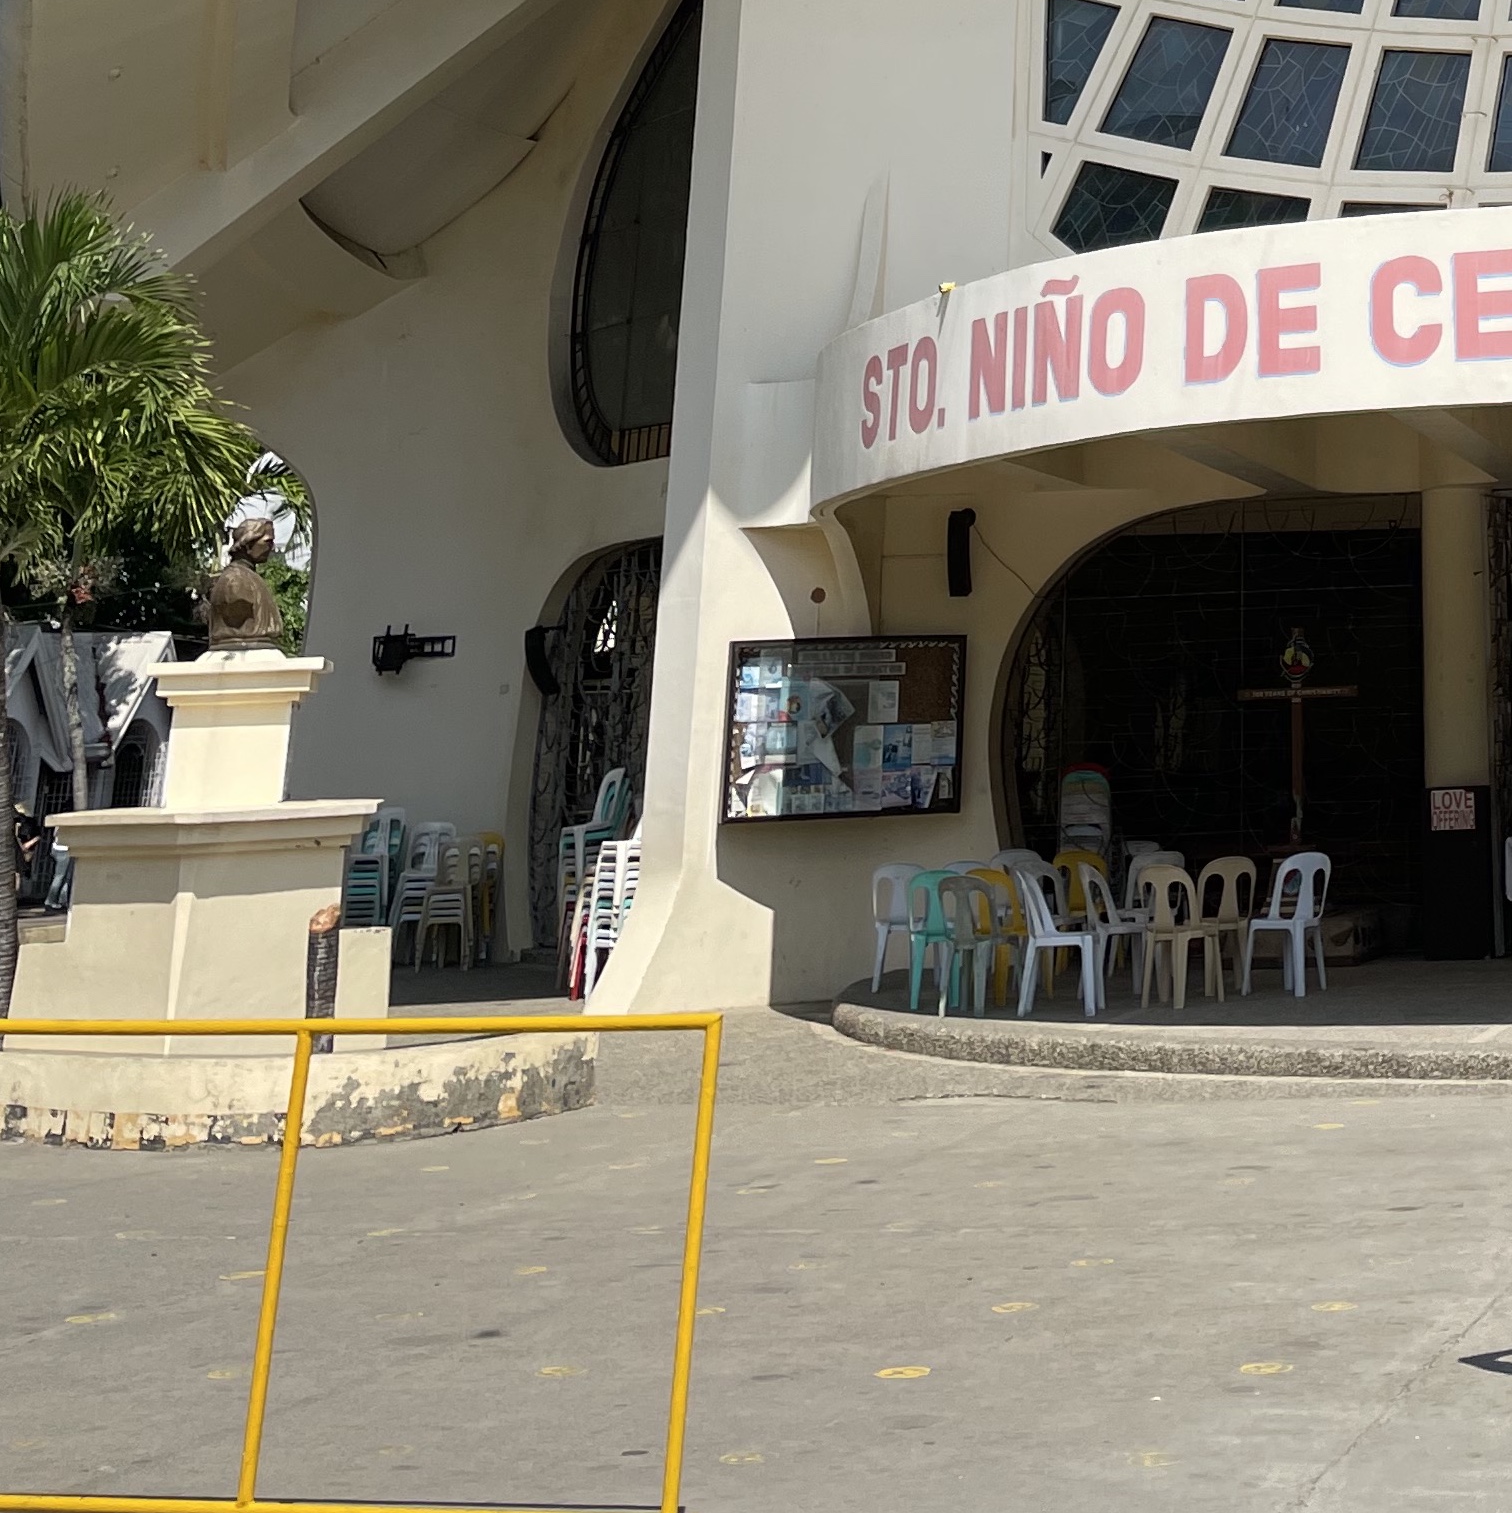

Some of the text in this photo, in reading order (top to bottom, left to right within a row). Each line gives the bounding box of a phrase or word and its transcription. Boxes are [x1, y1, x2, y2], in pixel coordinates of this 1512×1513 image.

[861, 335, 945, 450] STO.
[968, 275, 1146, 422] NIÑO
[1184, 263, 1321, 387] DE
[1432, 790, 1473, 809] LOVE
[1431, 810, 1475, 830] OFFERING
